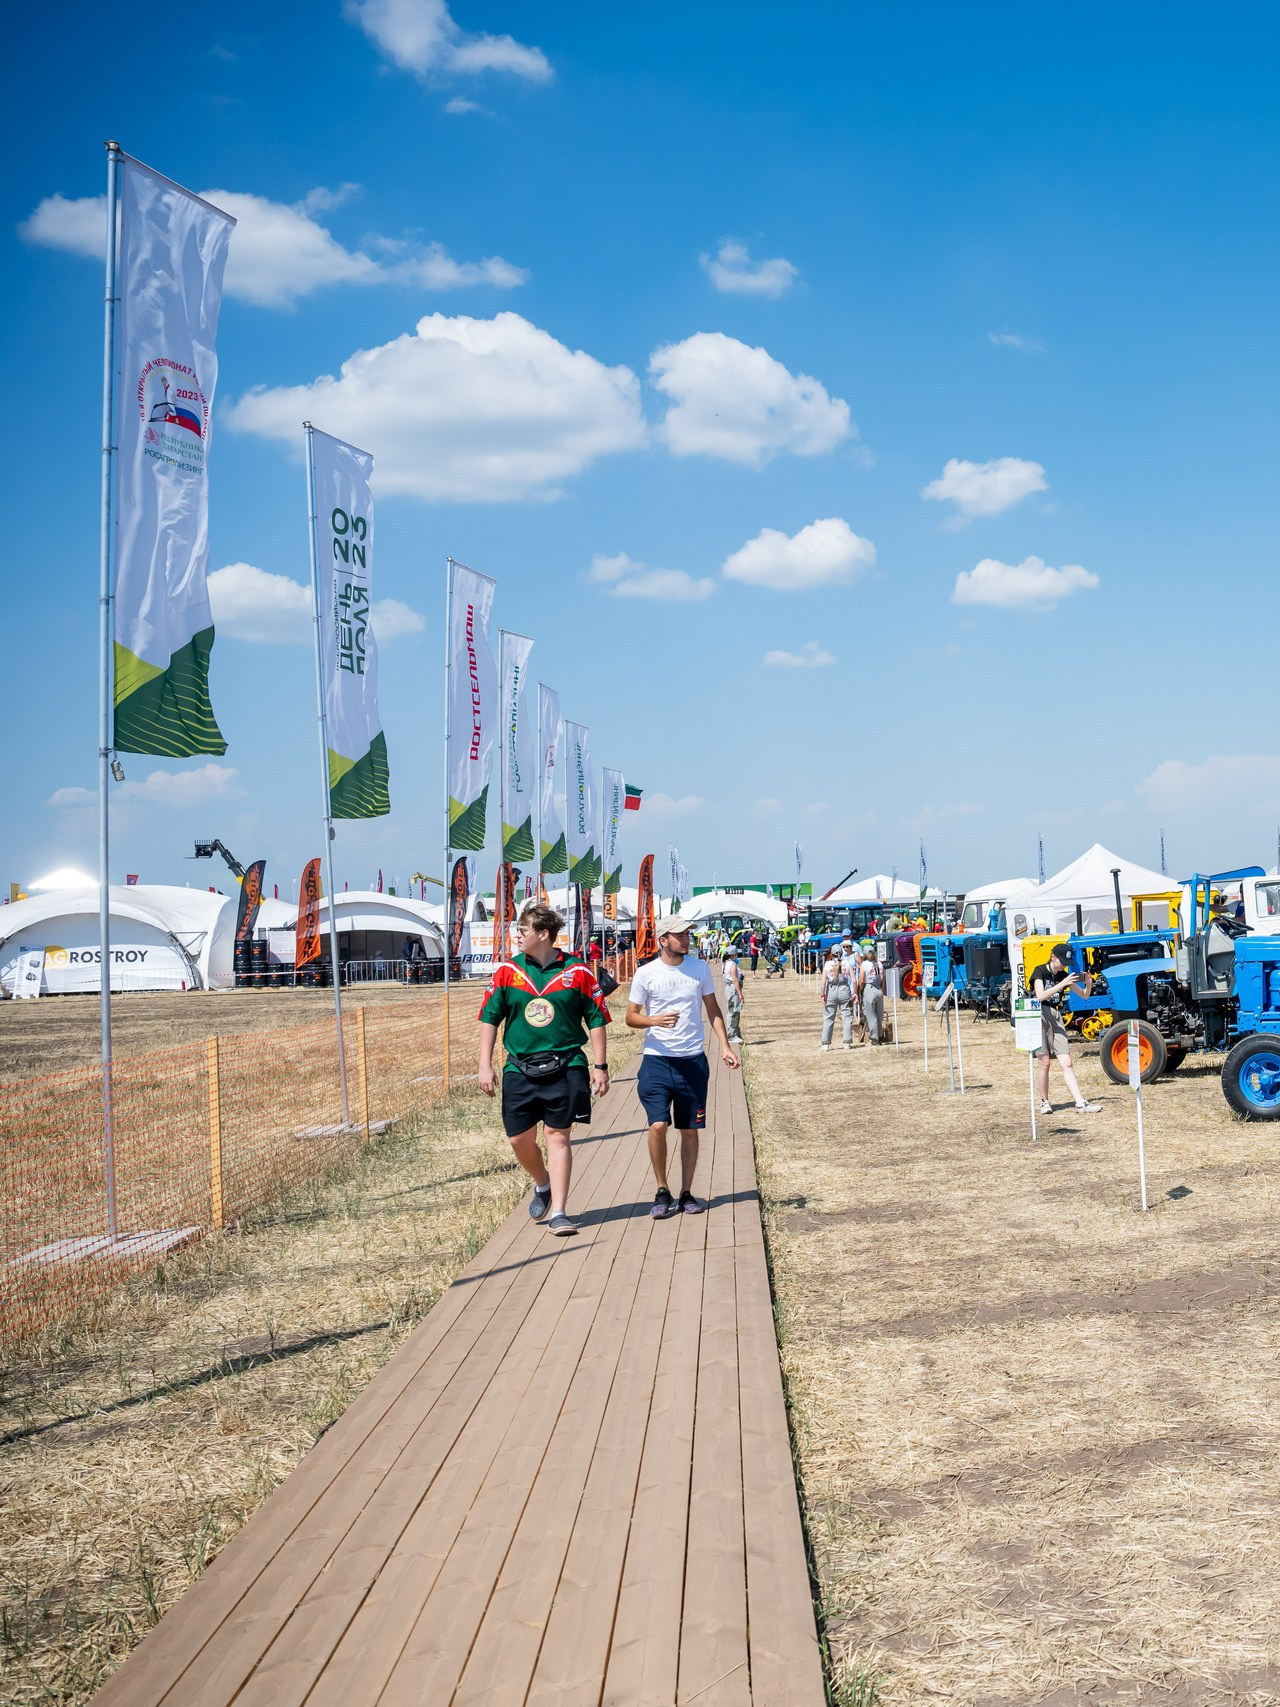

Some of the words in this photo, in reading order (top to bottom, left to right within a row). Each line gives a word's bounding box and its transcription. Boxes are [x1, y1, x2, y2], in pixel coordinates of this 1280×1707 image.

[176, 388, 199, 401] 2023
[203, 406, 209, 417] ПО
[331, 507, 350, 564] 20
[351, 514, 367, 569] 23
[338, 582, 355, 674] ДЕНЬ
[465, 603, 482, 761] РОСТСЕЛЬМАШ
[576, 741, 586, 835] РОСАГРОЛИЗИНГ
